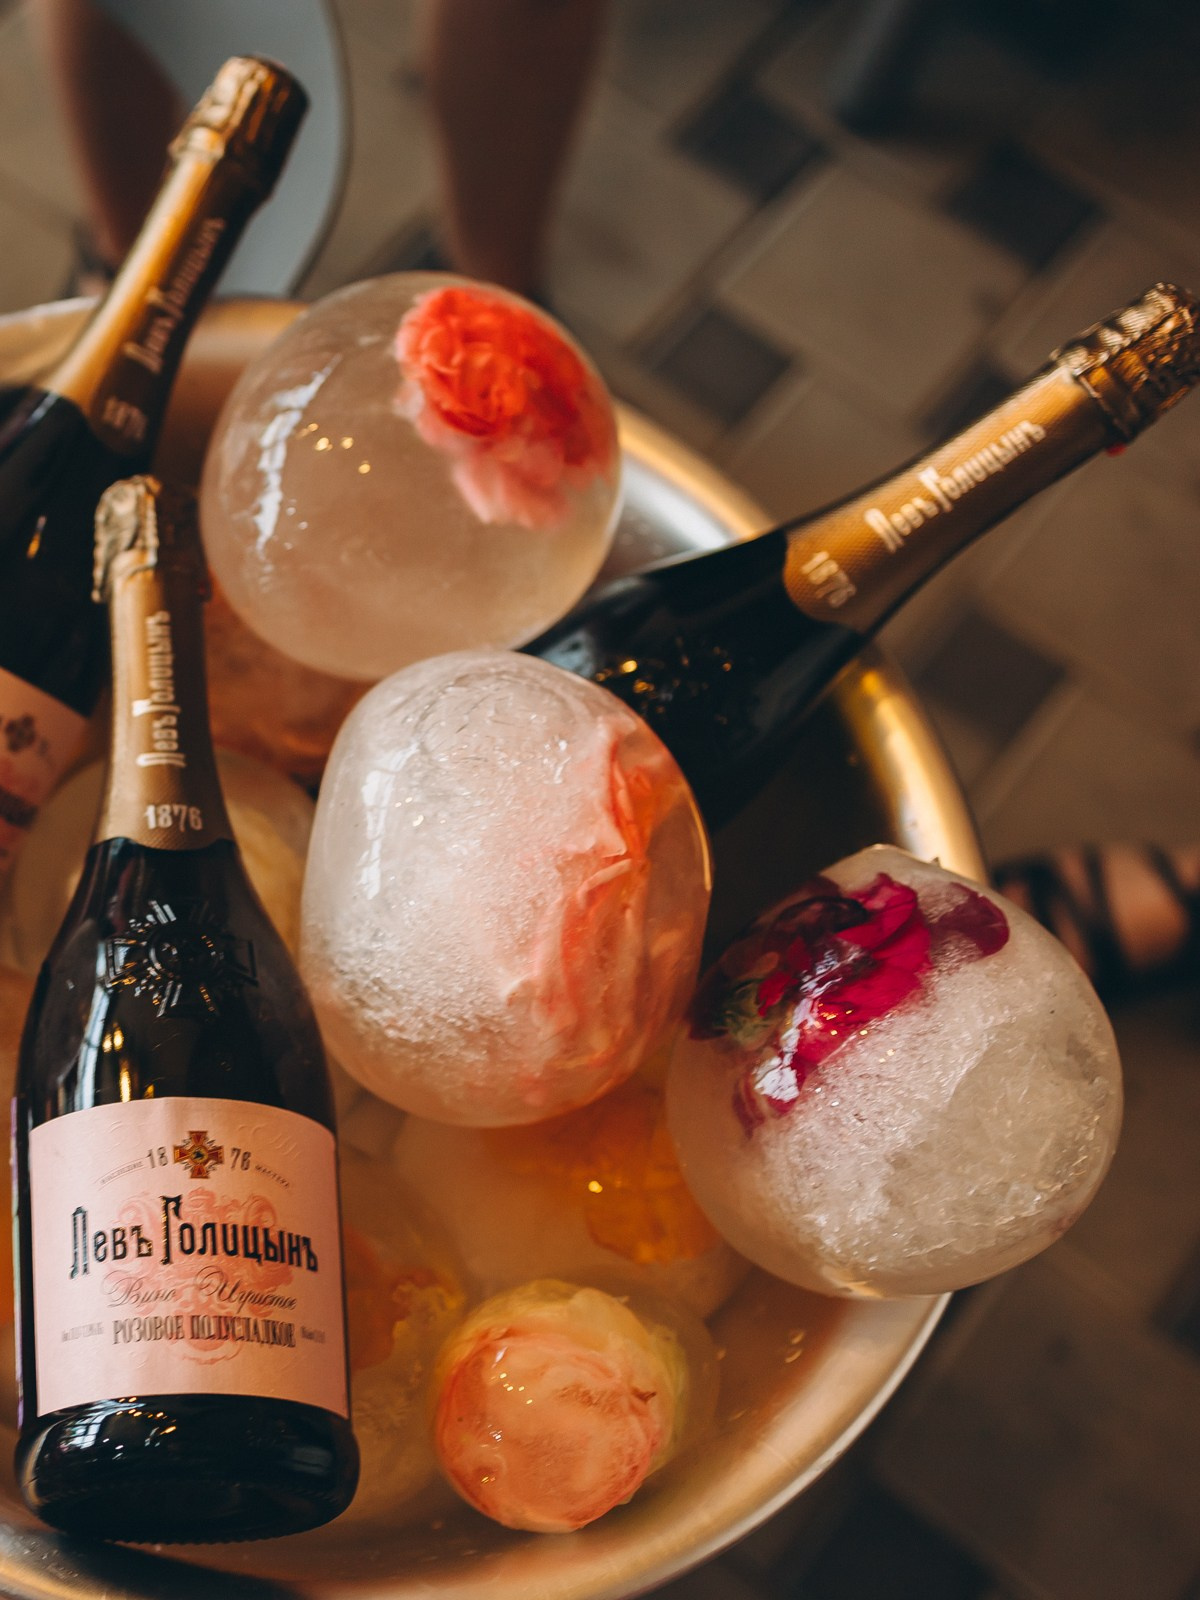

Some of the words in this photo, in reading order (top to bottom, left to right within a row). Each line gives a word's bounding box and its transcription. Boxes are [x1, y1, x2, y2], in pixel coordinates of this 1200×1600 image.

[144, 803, 203, 832] 1876
[146, 1146, 169, 1170] 18
[69, 1205, 153, 1280] Левъ
[158, 1194, 319, 1273] Голицынъ
[111, 1314, 186, 1346] РОЗОВОЕ
[189, 1314, 297, 1348] ПОЛУСЛАДКОЕ
